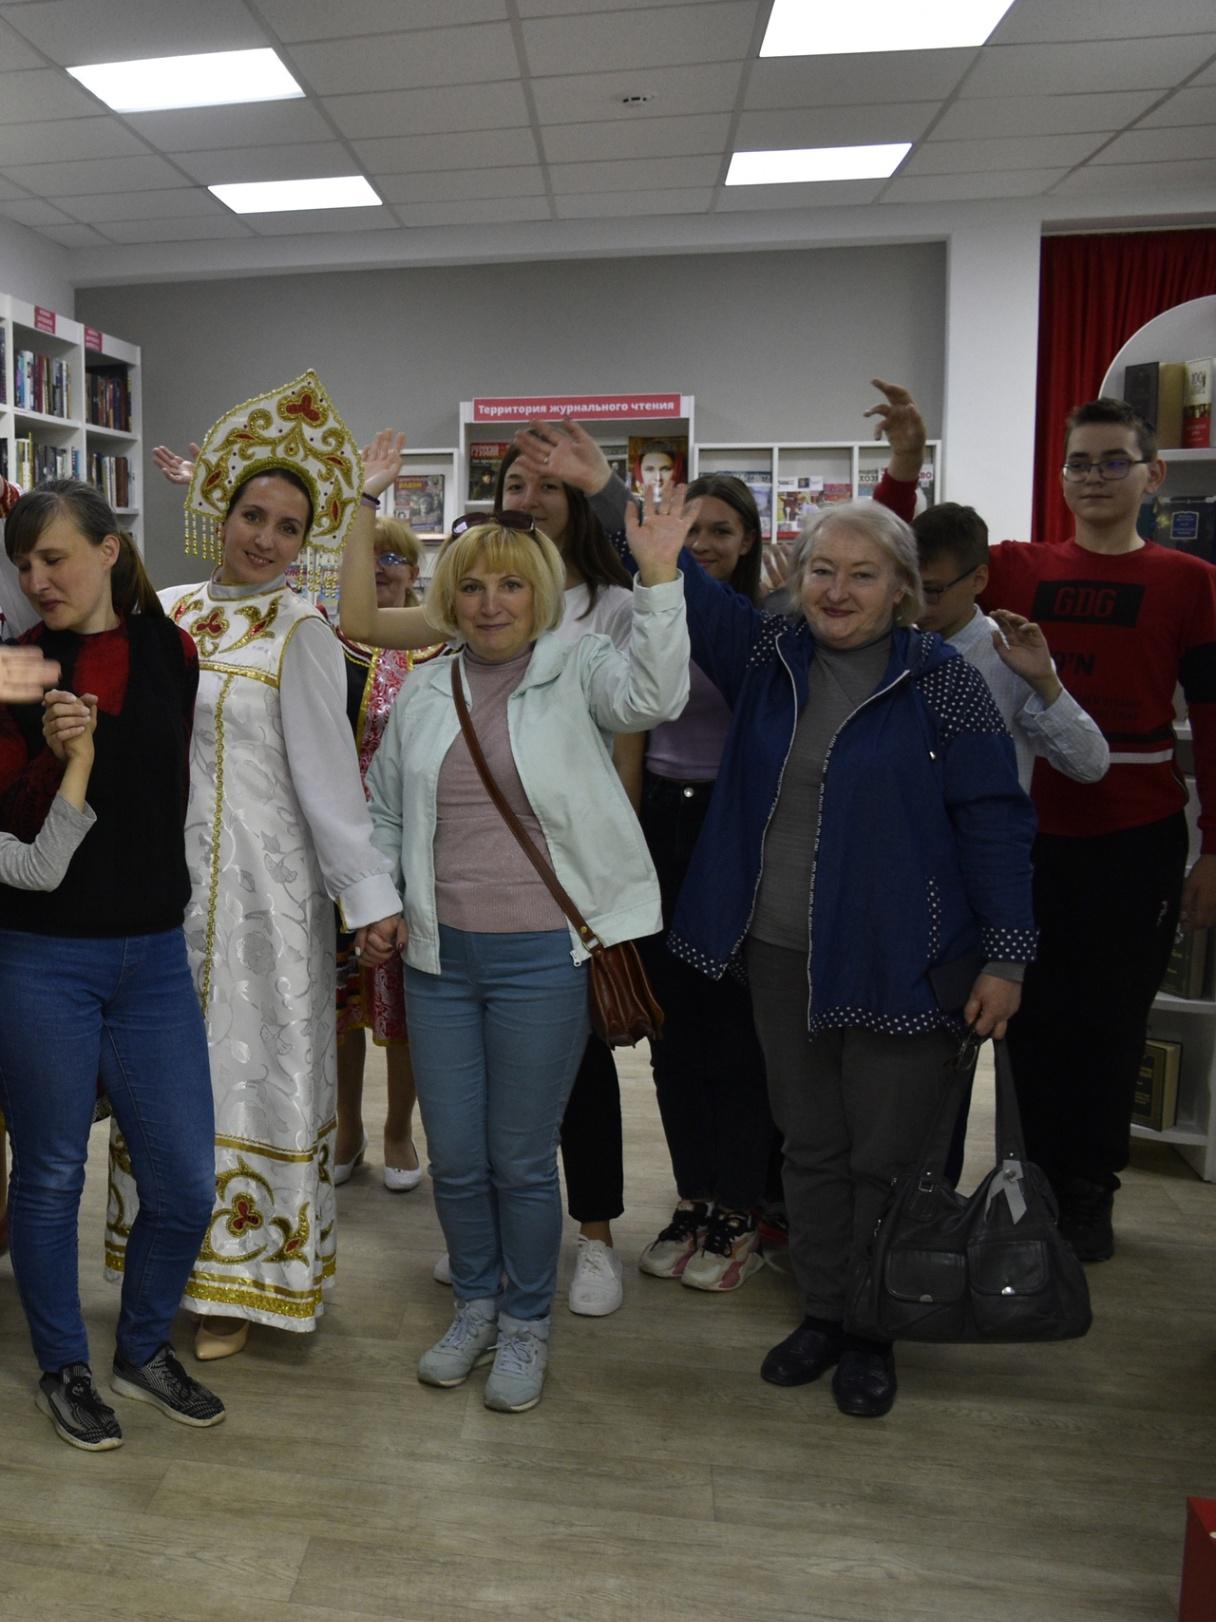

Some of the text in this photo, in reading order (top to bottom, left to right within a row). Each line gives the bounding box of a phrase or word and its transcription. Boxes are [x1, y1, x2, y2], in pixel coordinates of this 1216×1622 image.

[478, 401, 675, 417] Территория журнального чтения
